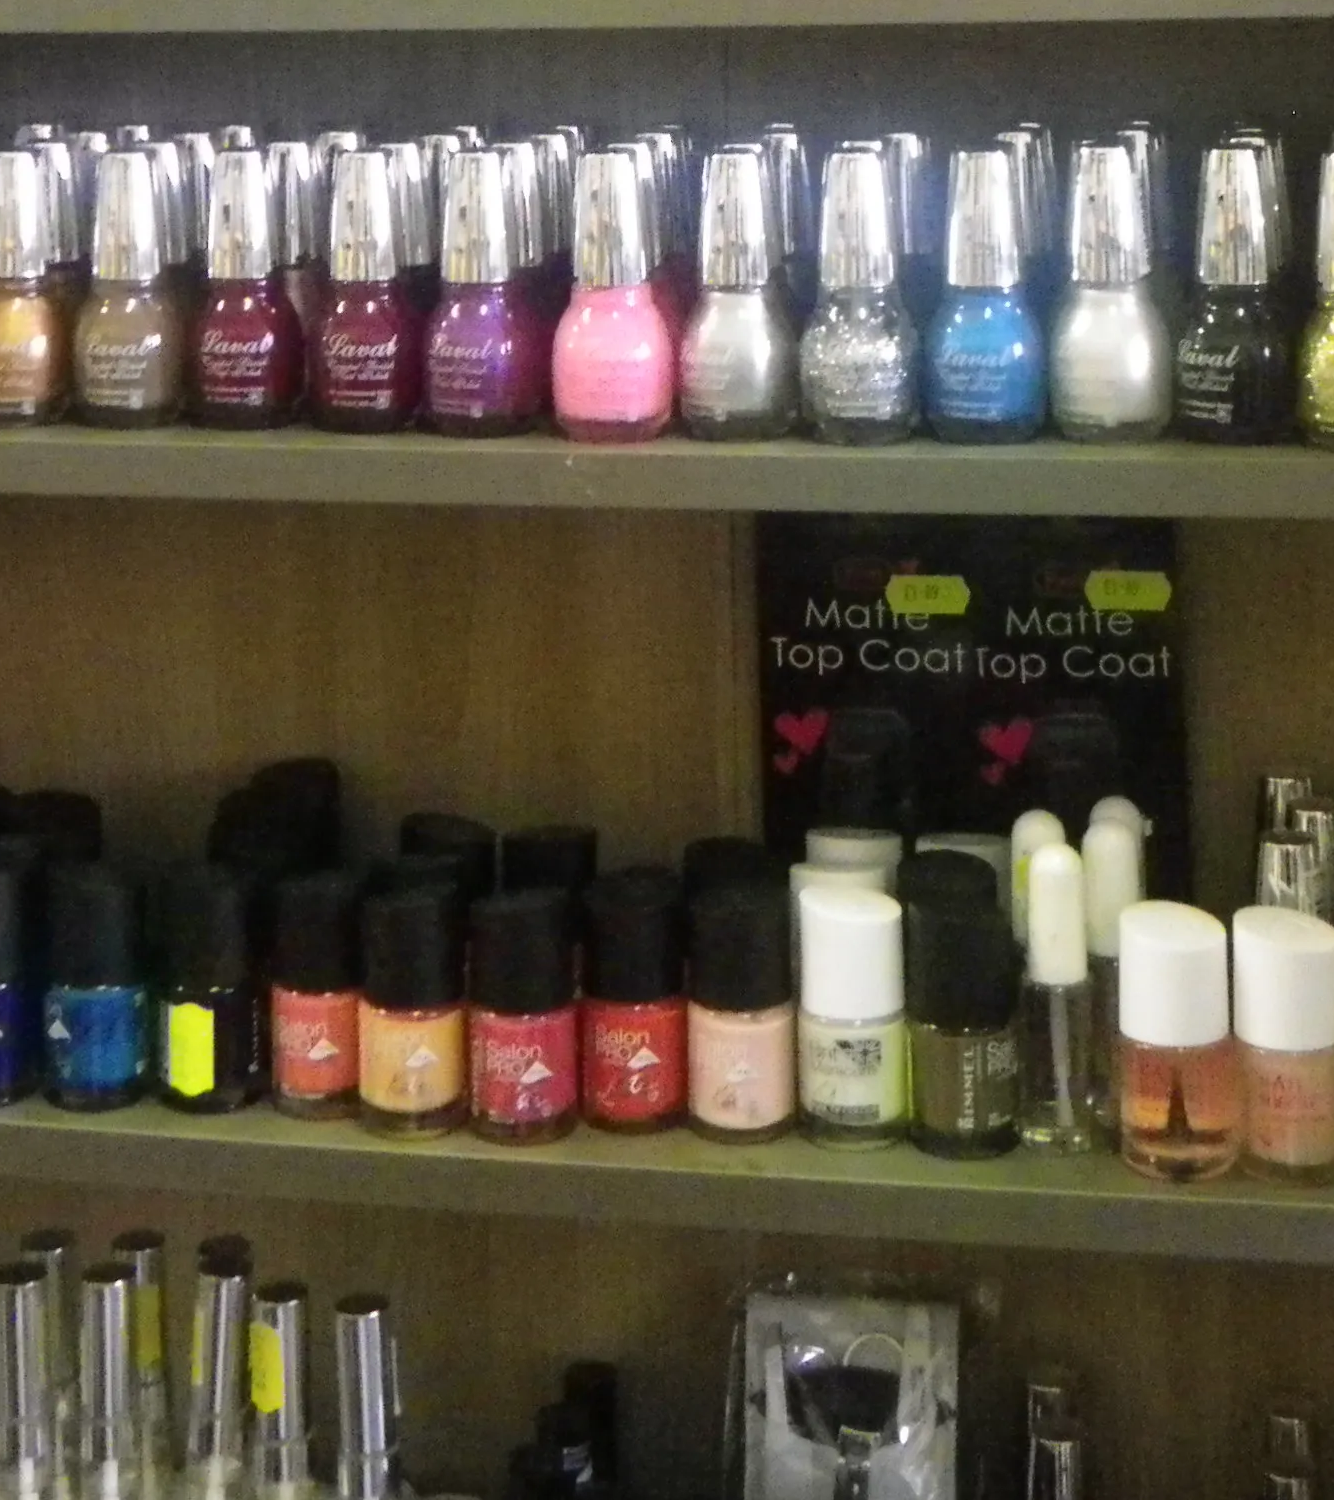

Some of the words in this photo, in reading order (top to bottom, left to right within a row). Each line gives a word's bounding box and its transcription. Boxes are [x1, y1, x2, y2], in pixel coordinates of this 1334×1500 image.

[325, 333, 399, 357] Laval
[805, 598, 931, 632] Matte
[1005, 604, 1135, 637] Matte
[771, 636, 845, 675] Top
[859, 638, 966, 674] Coat
[976, 646, 1048, 685] Top
[1062, 644, 1171, 680] Coat
